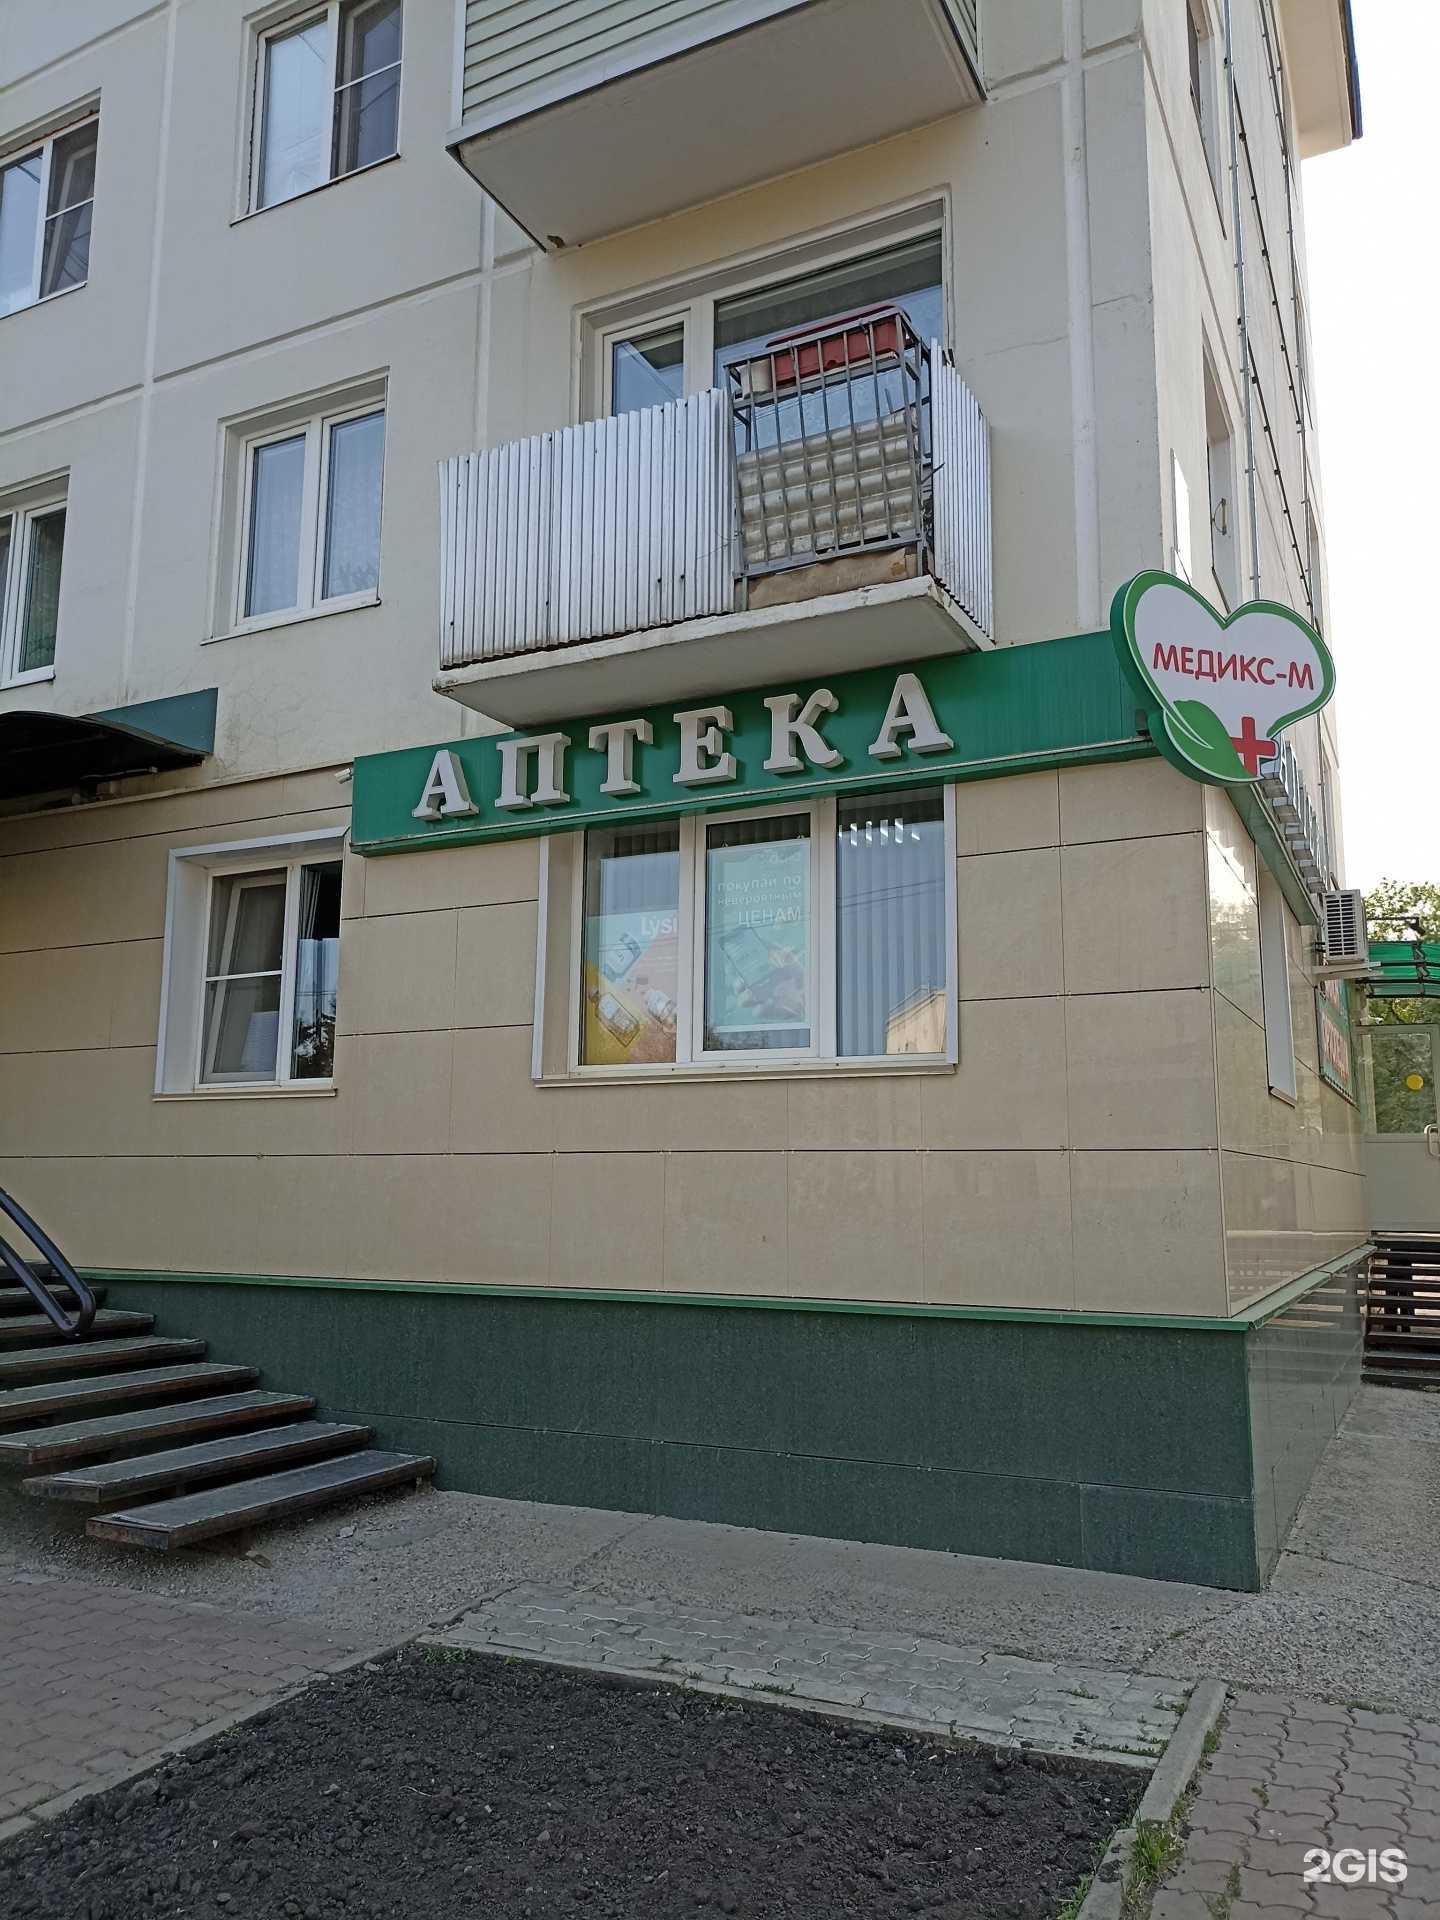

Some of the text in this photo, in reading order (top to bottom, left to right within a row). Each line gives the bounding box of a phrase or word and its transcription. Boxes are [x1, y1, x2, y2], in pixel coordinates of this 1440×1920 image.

[1153, 642, 1315, 691] МЕДИКС-М
[411, 673, 954, 822] АПТЕКА
[738, 905, 801, 927] ЦЕНАМ
